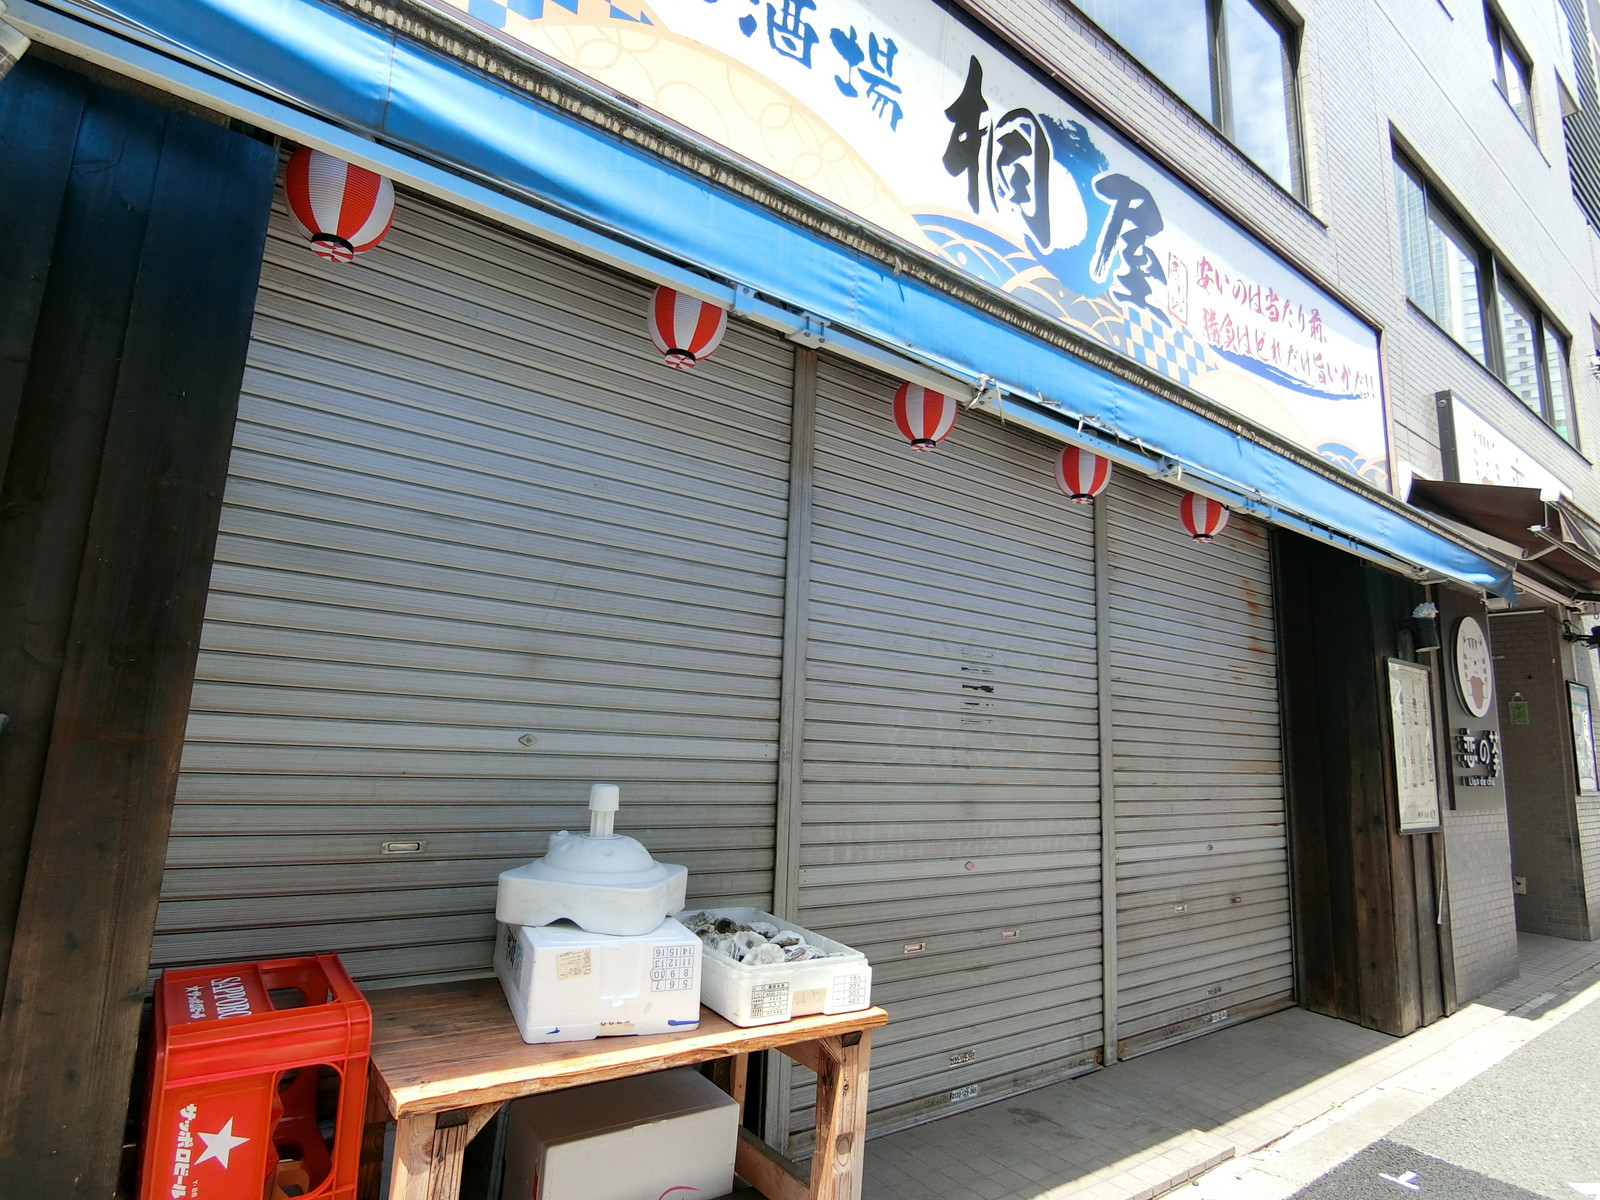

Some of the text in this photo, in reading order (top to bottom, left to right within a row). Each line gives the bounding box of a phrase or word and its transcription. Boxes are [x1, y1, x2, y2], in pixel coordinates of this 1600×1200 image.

[701, 0, 1173, 328] 酒場 桐屋
[656, 947, 692, 957] 14 15 16
[654, 958, 691, 968] 11 12 13
[654, 968, 688, 979] 8 9 10
[656, 980, 688, 990] 5 6 7
[210, 976, 253, 1020] SAPPORO
[171, 1103, 198, 1199] サッポロビール
